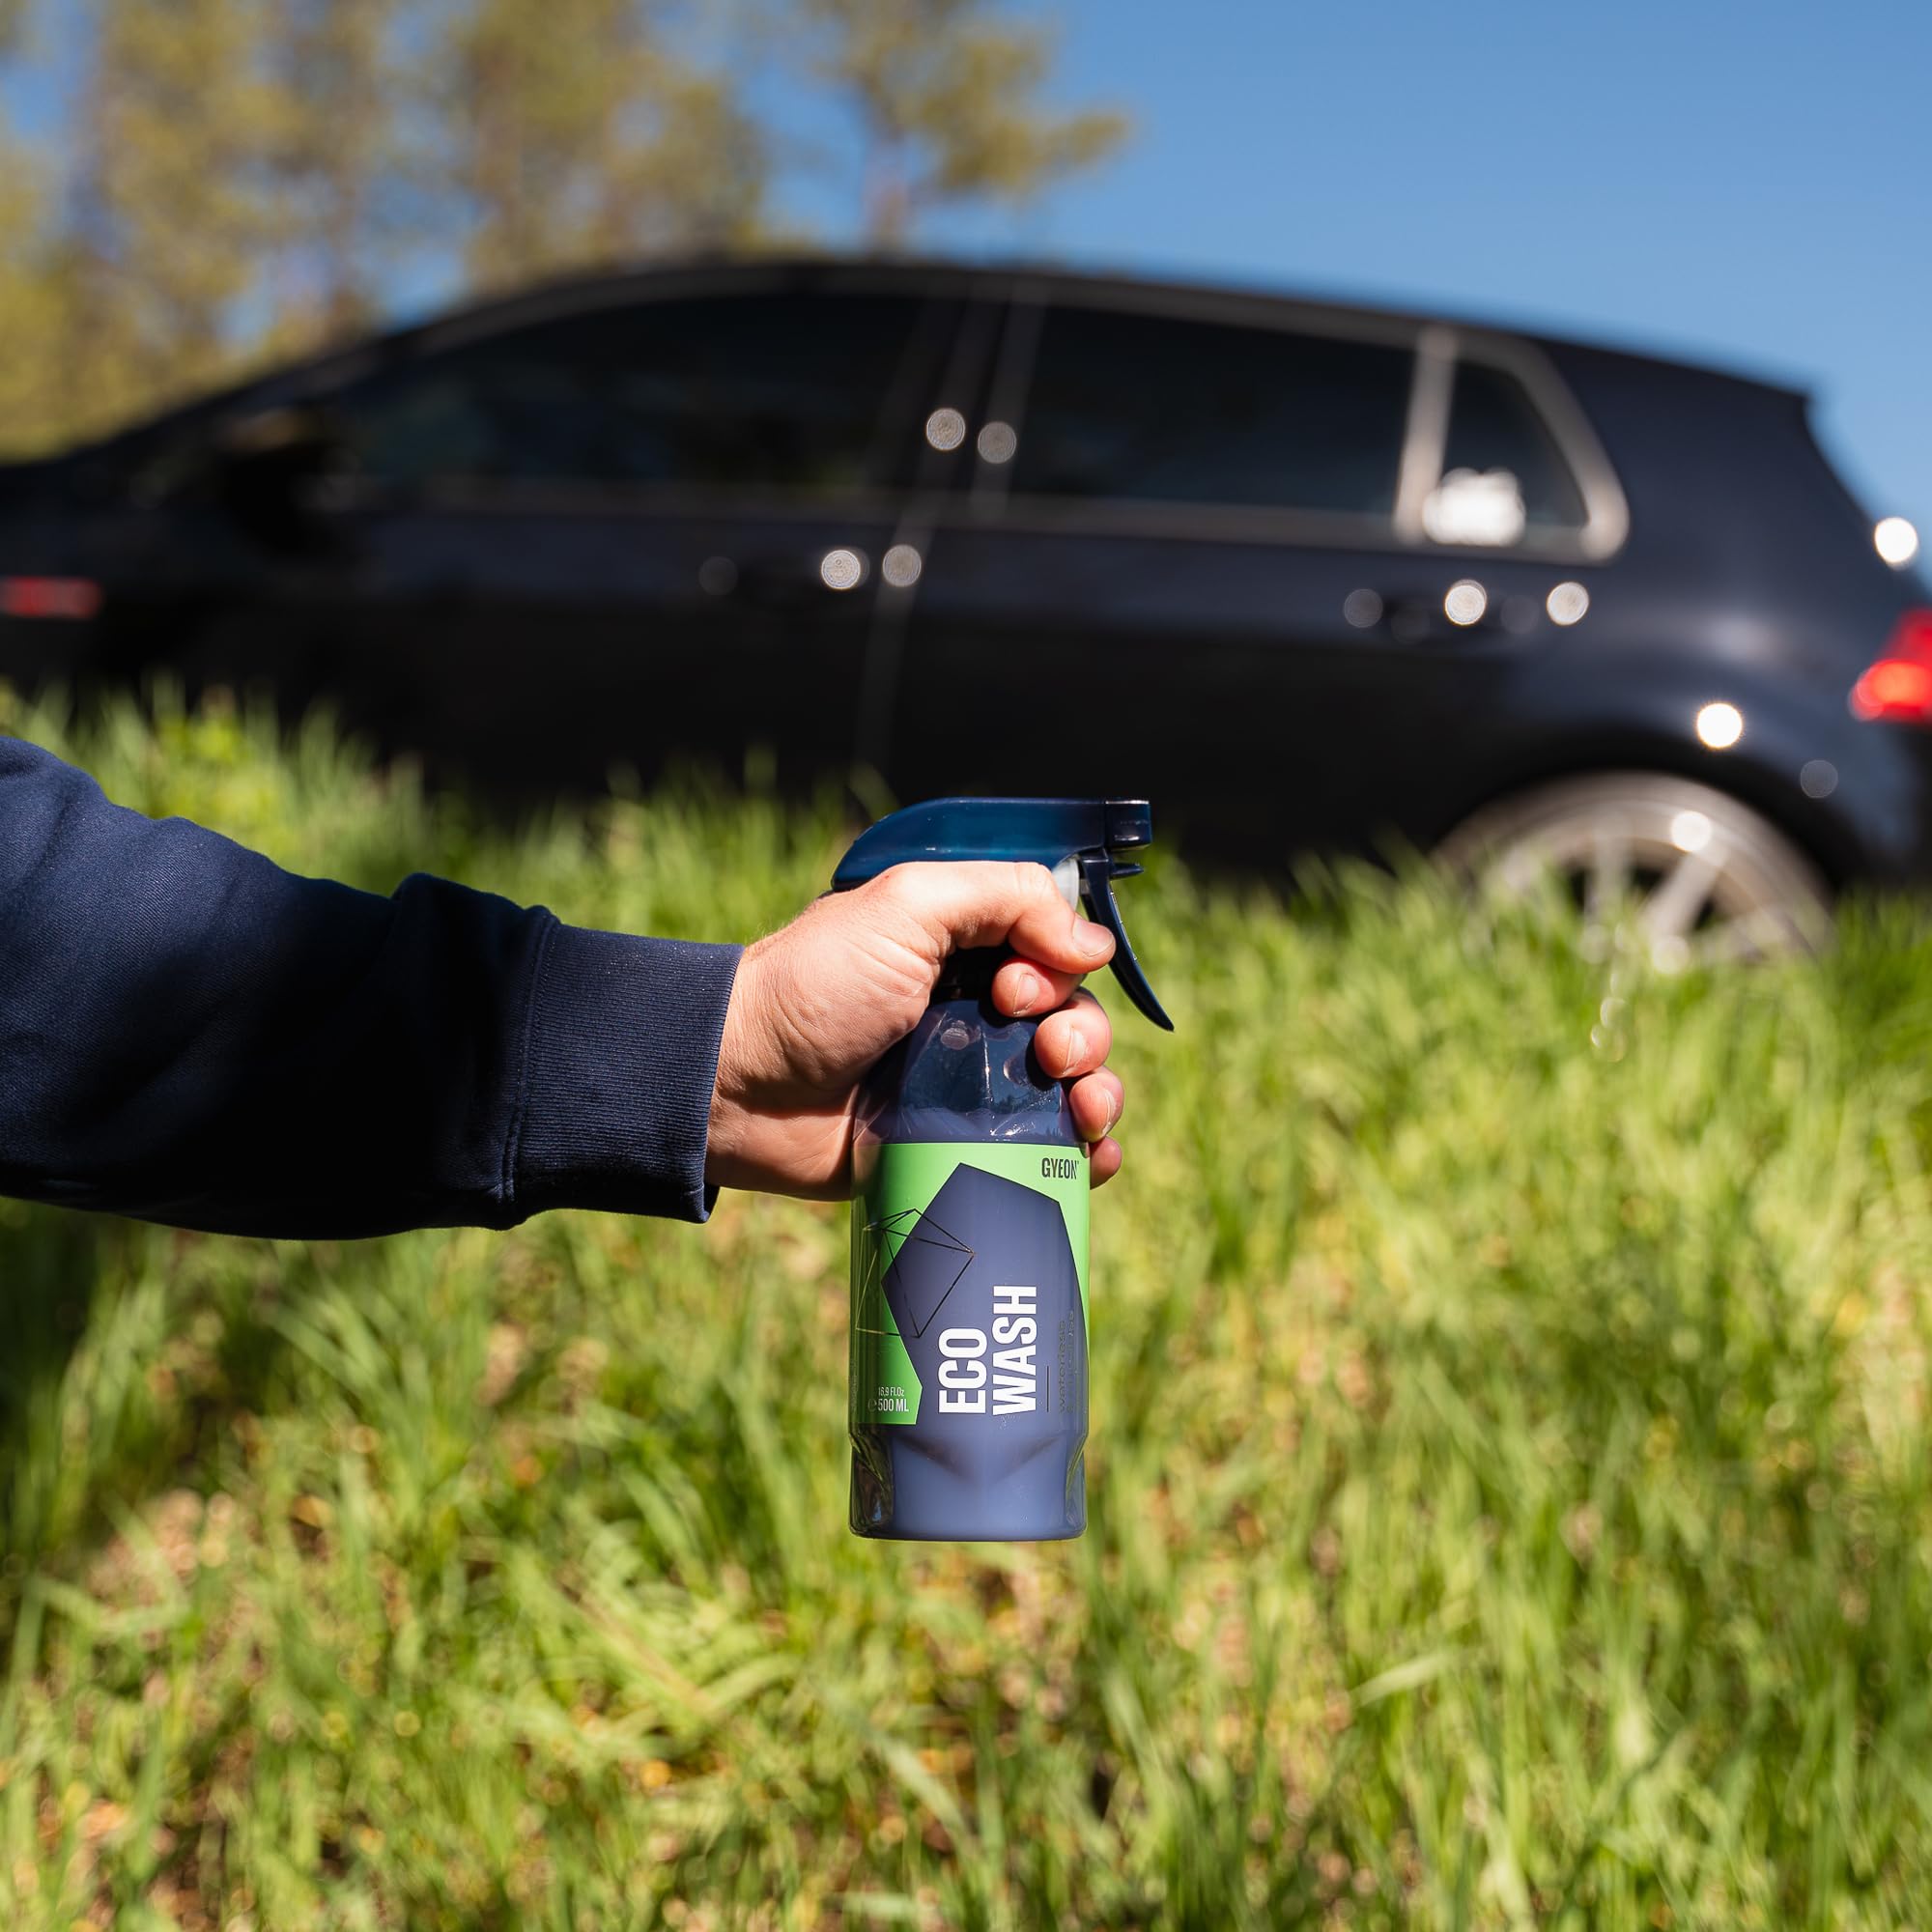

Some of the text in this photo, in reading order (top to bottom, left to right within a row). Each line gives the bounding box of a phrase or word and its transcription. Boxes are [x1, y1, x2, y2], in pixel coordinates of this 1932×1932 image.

[1041, 1157, 1077, 1179] GYEON
[937, 1327, 987, 1415] ECO
[992, 1285, 1037, 1416] WASH
[877, 1398, 895, 1412] 500
[895, 1398, 910, 1412] ML
